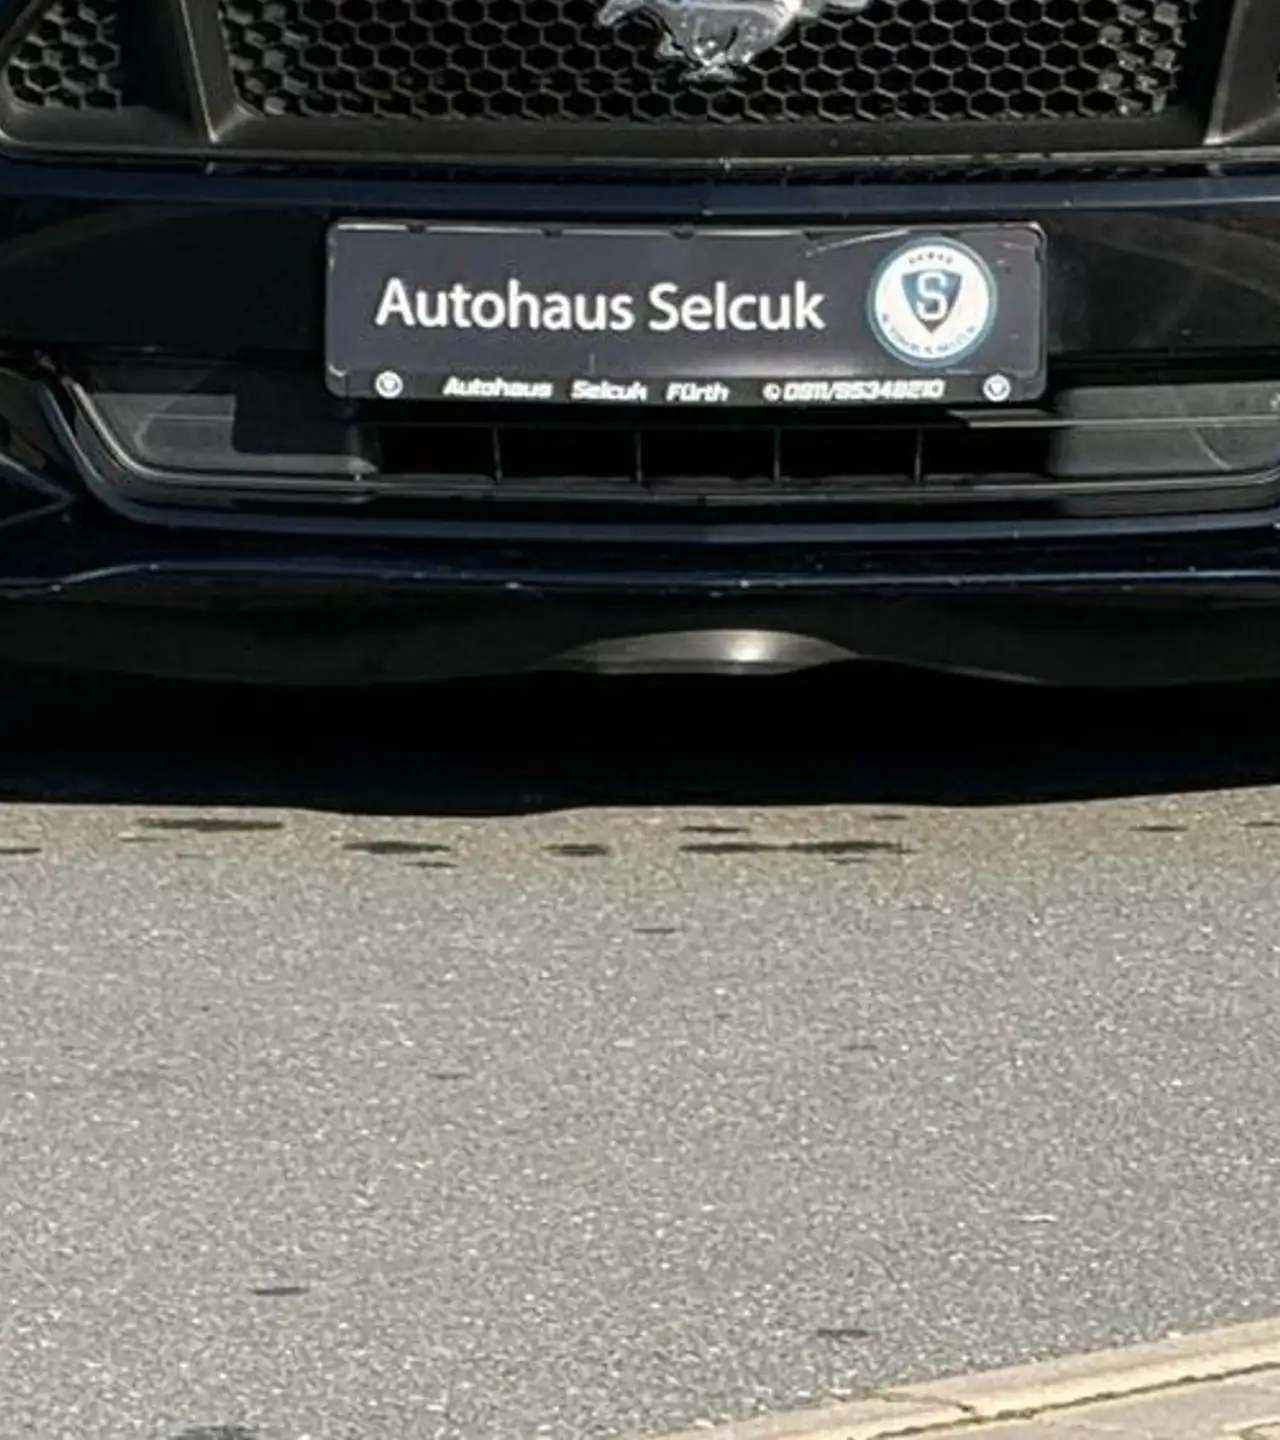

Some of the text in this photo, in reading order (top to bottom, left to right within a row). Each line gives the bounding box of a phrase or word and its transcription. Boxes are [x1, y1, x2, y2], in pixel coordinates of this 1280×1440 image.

[375, 276, 827, 332] Autohaus Selcuk
[441, 376, 554, 399] Autohaus
[569, 379, 648, 401] Selcuk
[665, 379, 731, 403] Fürth
